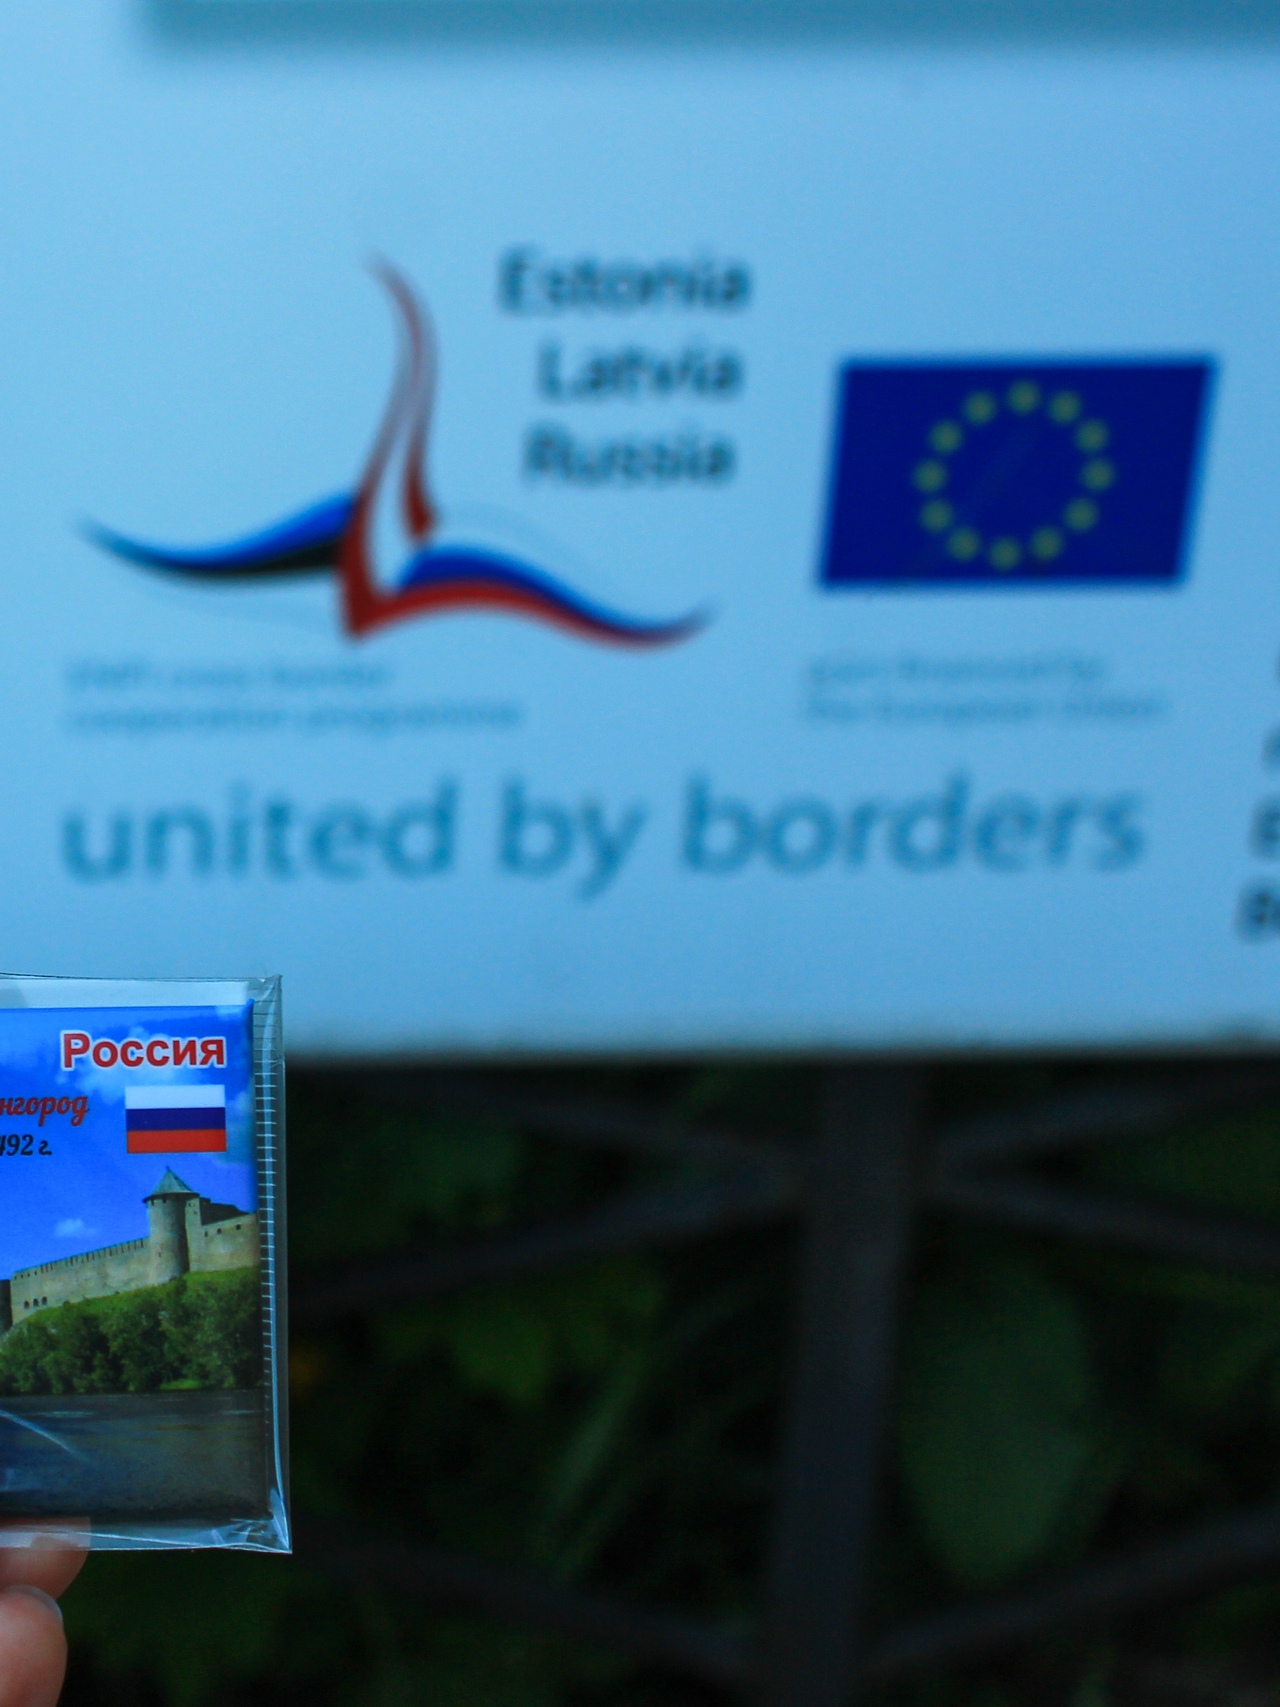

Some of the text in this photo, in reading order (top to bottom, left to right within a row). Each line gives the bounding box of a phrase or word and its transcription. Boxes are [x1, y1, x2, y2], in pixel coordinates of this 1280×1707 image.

[500, 249, 750, 312] Estonia
[539, 342, 743, 398] Latvia
[524, 426, 734, 487] Russia
[62, 776, 458, 880] united
[500, 775, 646, 902] by
[682, 770, 1145, 874] borders
[62, 1030, 226, 1070] Россия
